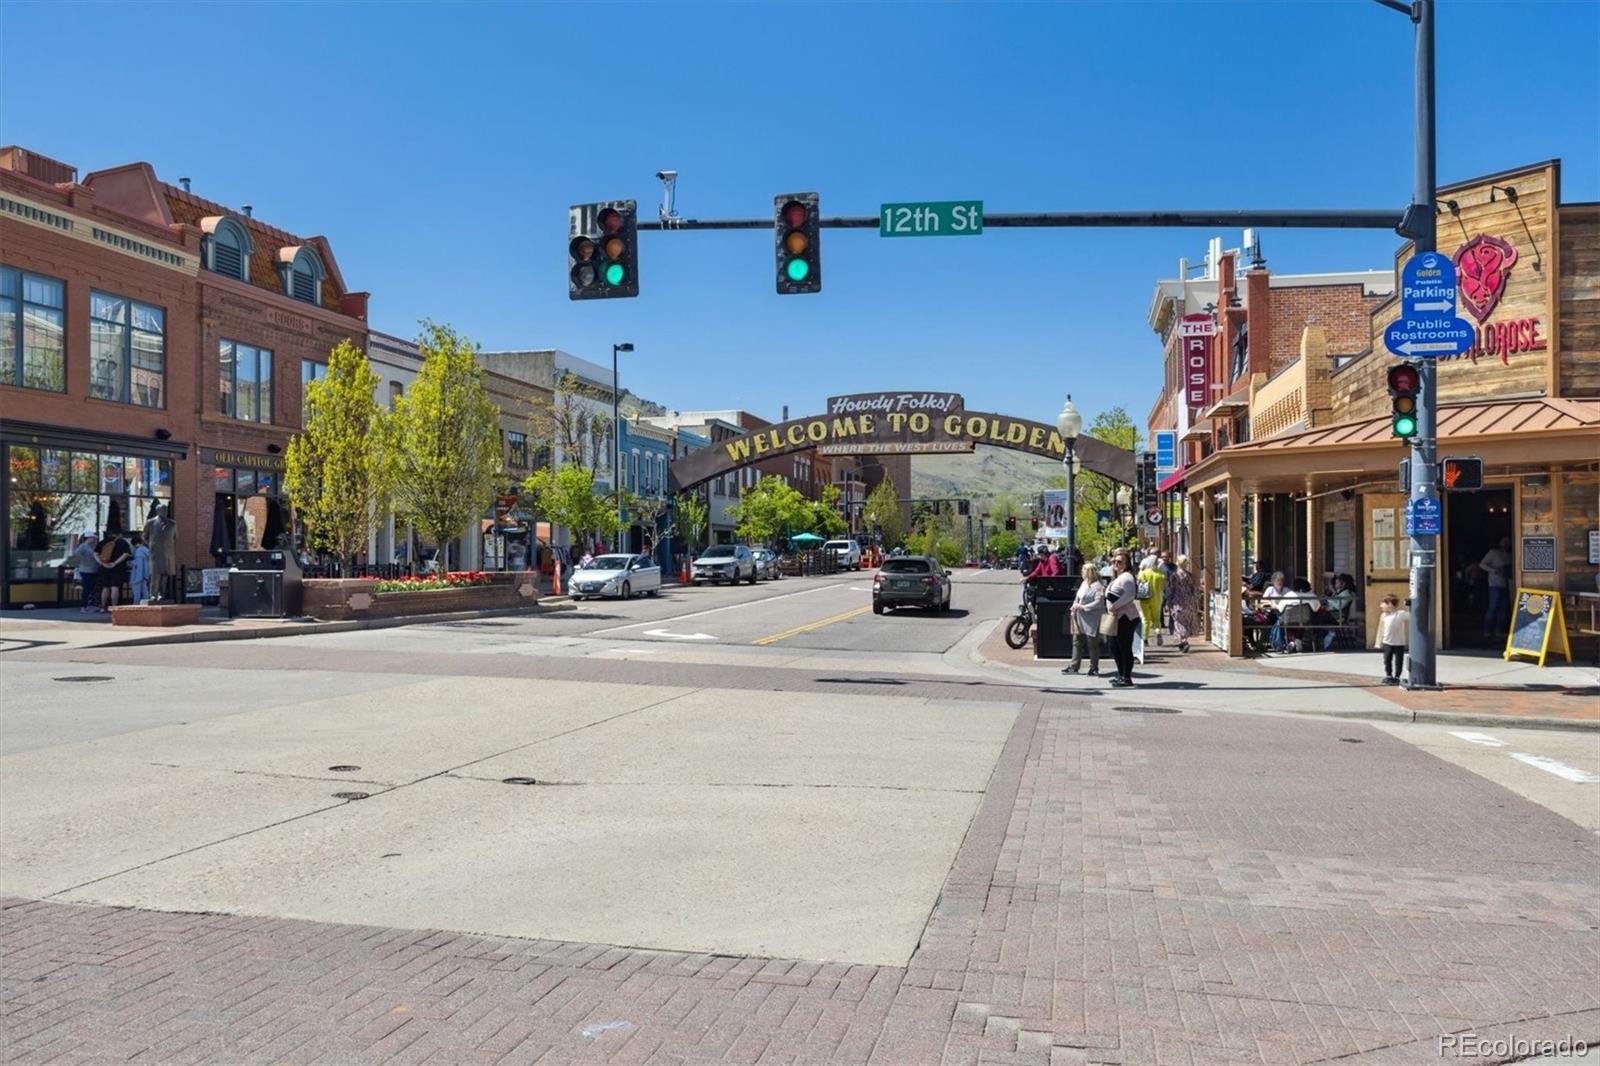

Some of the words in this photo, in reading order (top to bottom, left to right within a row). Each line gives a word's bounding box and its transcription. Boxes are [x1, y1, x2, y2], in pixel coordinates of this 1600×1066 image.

[884, 207, 940, 232] 12th
[951, 205, 978, 231] St
[1416, 269, 1442, 277] Golden
[1403, 286, 1455, 300] Parking
[1182, 324, 1213, 333] THE
[1406, 319, 1451, 330] Public
[1390, 329, 1468, 340] Restrooms
[1190, 339, 1205, 402] ROSE
[832, 394, 895, 414] Howdy
[896, 394, 955, 413] Folks!
[725, 414, 875, 463] WELCOME
[886, 412, 930, 434] TO
[944, 414, 1066, 454] GOLDEN
[822, 444, 864, 454] WHERE
[869, 443, 891, 453] THE
[895, 442, 927, 452] WEST
[932, 441, 967, 451] LIVES
[215, 452, 234, 463] OLD
[237, 454, 272, 467] CAPITOL
